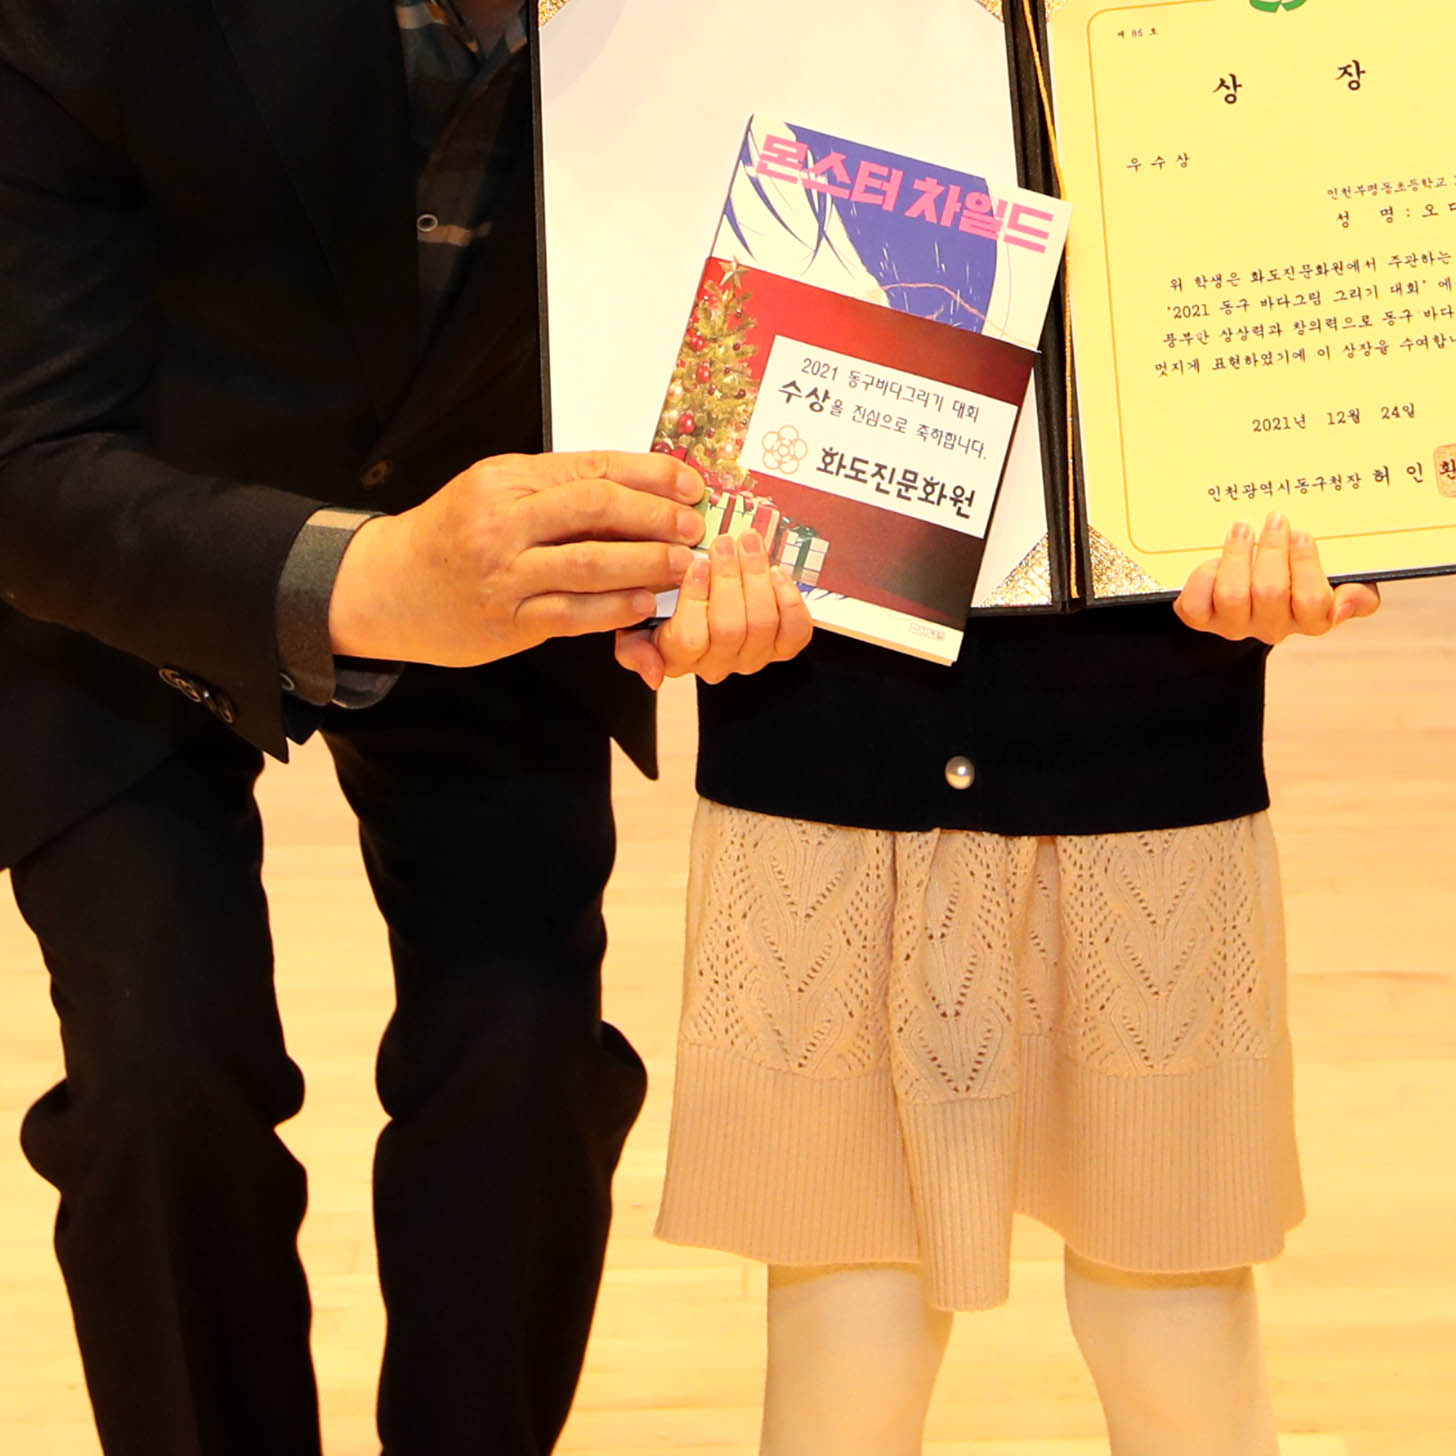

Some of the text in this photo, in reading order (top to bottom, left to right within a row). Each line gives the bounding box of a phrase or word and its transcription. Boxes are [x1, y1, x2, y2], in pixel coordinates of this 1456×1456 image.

[1212, 59, 1367, 105] 상 장
[756, 134, 1054, 254] 몬스터 차일드
[1170, 250, 1452, 292] 위 학생은 화도진문화원에서 주관하는
[1219, 298, 1250, 316] 동구
[1259, 290, 1321, 310] 바다그림
[1333, 284, 1379, 303] 그리기
[1163, 329, 1210, 349] 풍부한
[1220, 322, 1283, 343] 상상력과
[1293, 314, 1373, 336] 창의력으로
[1381, 308, 1414, 327] 동구
[1211, 347, 1306, 371] 표현하였기에
[1316, 345, 1331, 361] 이
[1343, 339, 1390, 359] 상장을
[801, 357, 980, 423] 2021 동구바다그리기 대회
[778, 380, 988, 461] 수상을 진심으로 축하합니다.
[1252, 402, 1415, 433] 2021년 12월 24일
[816, 446, 976, 520] 화도진문화원
[1207, 472, 1362, 503] 인천광역시동구청장
